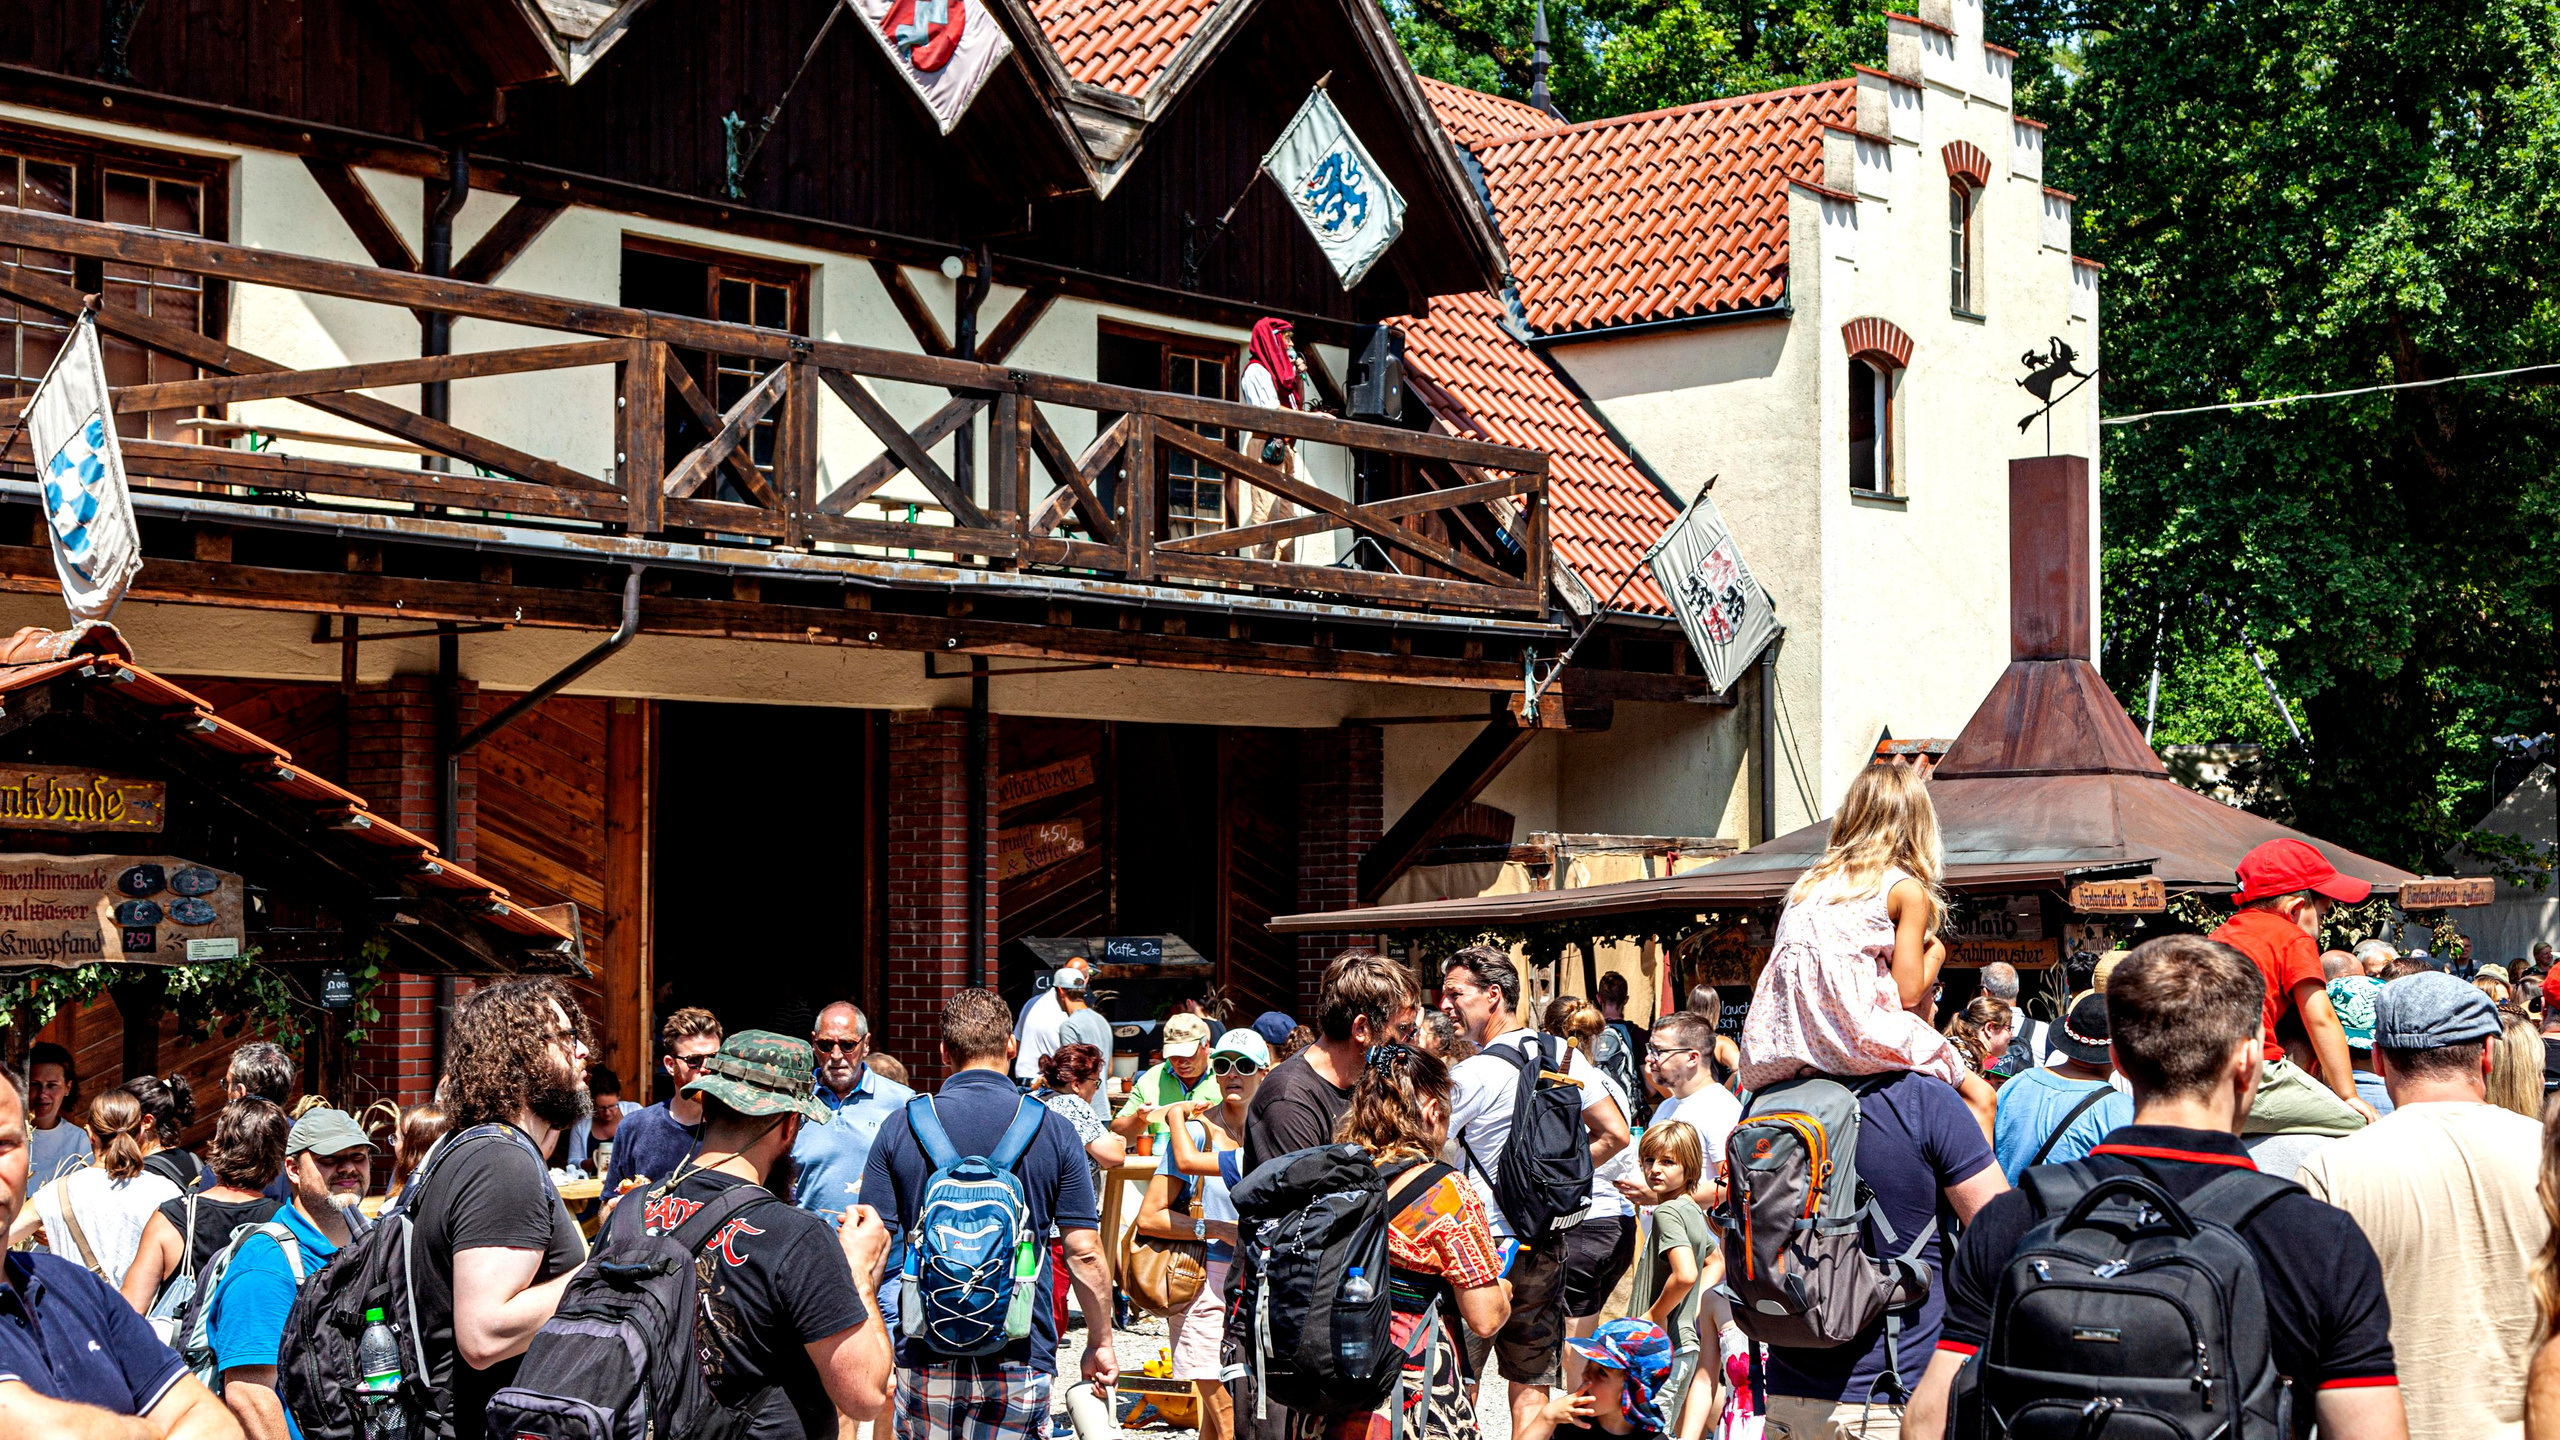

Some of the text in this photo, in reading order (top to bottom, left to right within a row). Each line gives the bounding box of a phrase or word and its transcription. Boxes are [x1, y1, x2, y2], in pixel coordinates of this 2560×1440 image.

[0, 774, 126, 822] nkbude
[0, 929, 102, 962] Krugpfand
[1107, 941, 1138, 957] Kaffe
